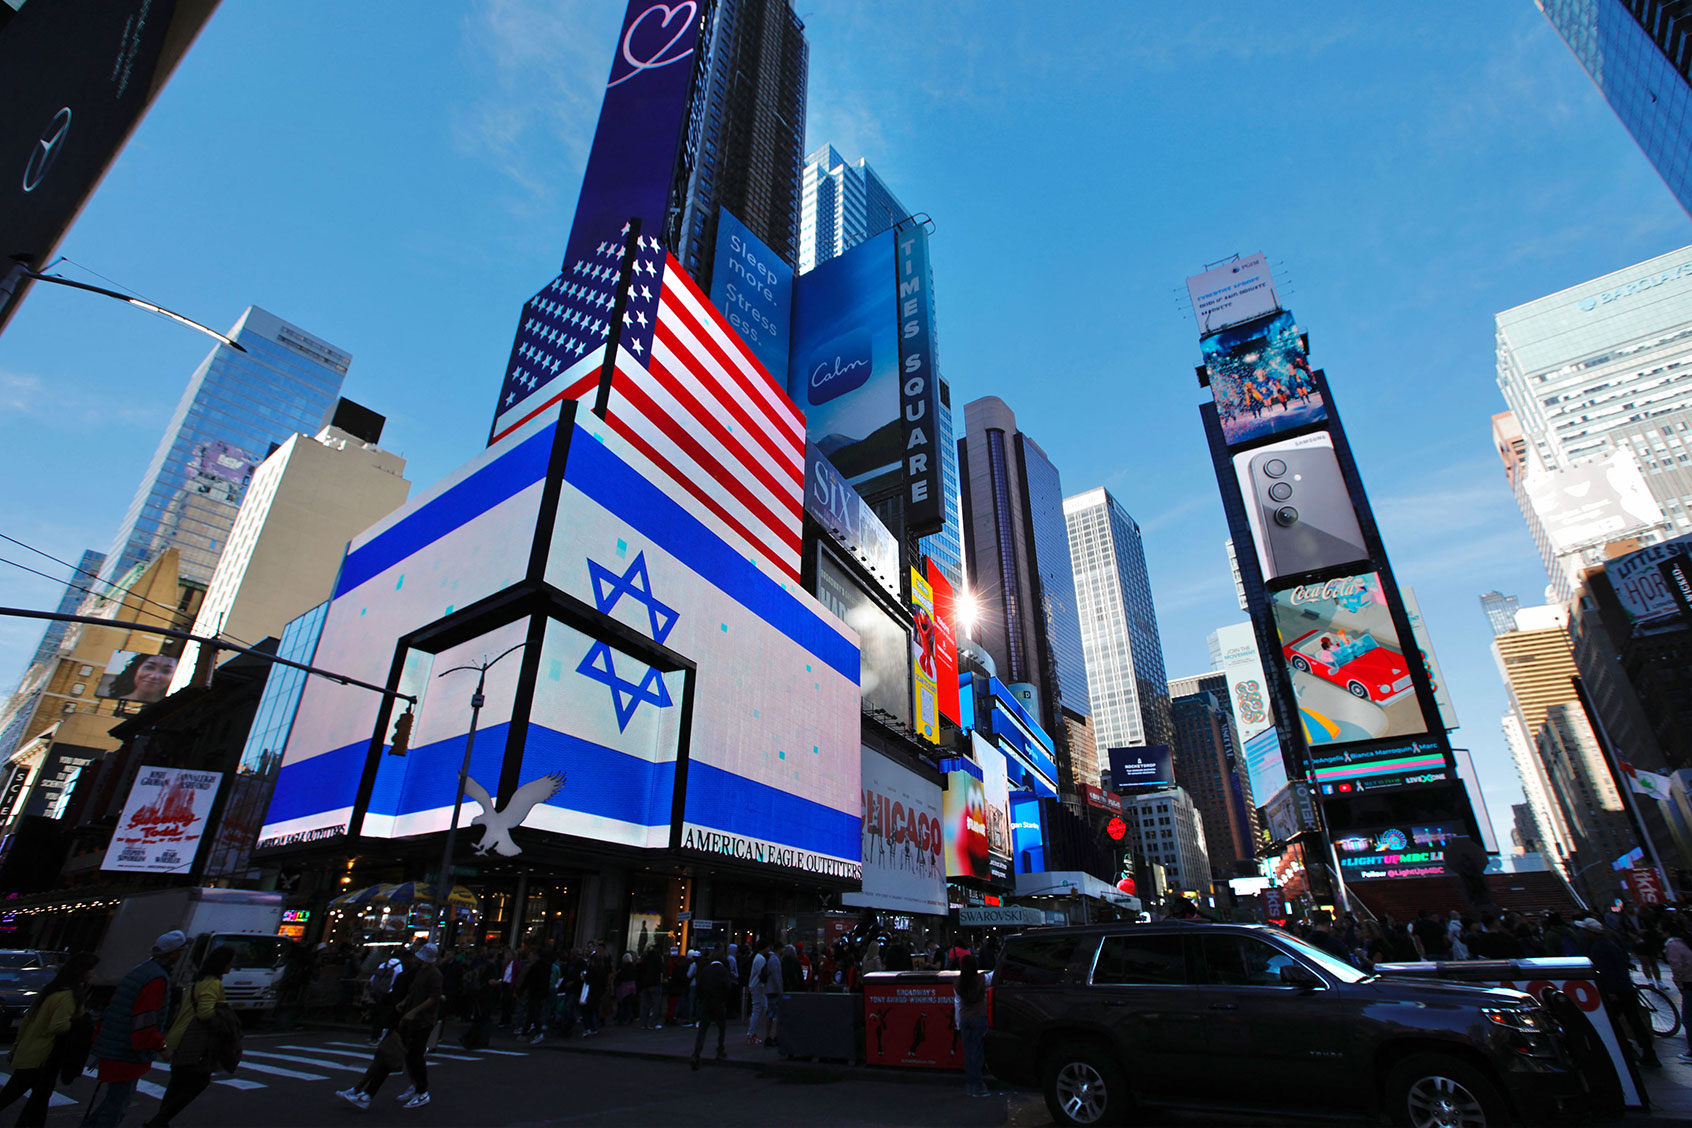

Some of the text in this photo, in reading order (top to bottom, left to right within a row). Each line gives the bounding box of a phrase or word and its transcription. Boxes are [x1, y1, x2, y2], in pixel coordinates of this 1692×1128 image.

[730, 235, 777, 285] Sleep
[729, 258, 777, 306] more.
[1598, 263, 1692, 304] BARCLAYS
[725, 302, 762, 346] less.
[726, 283, 776, 336] Stress
[811, 356, 868, 388] Calm
[900, 238, 928, 503] TIMES SQUARE
[1295, 434, 1326, 446] SAMSUNG
[813, 460, 850, 532] SIX
[1617, 546, 1665, 579] LITTLE
[1291, 576, 1357, 606] Coca-Cola
[1624, 573, 1672, 612] HOR
[1224, 650, 1256, 660] MOVEMENT
[141, 824, 185, 839] Todd
[684, 828, 863, 880] AMERICAN EAGLE OUTFITTERS
[1341, 852, 1429, 866] #LIGHTUPMBC
[1361, 867, 1445, 878] Follow @LightUpMBC
[960, 910, 1023, 922] SWAROVSKI
